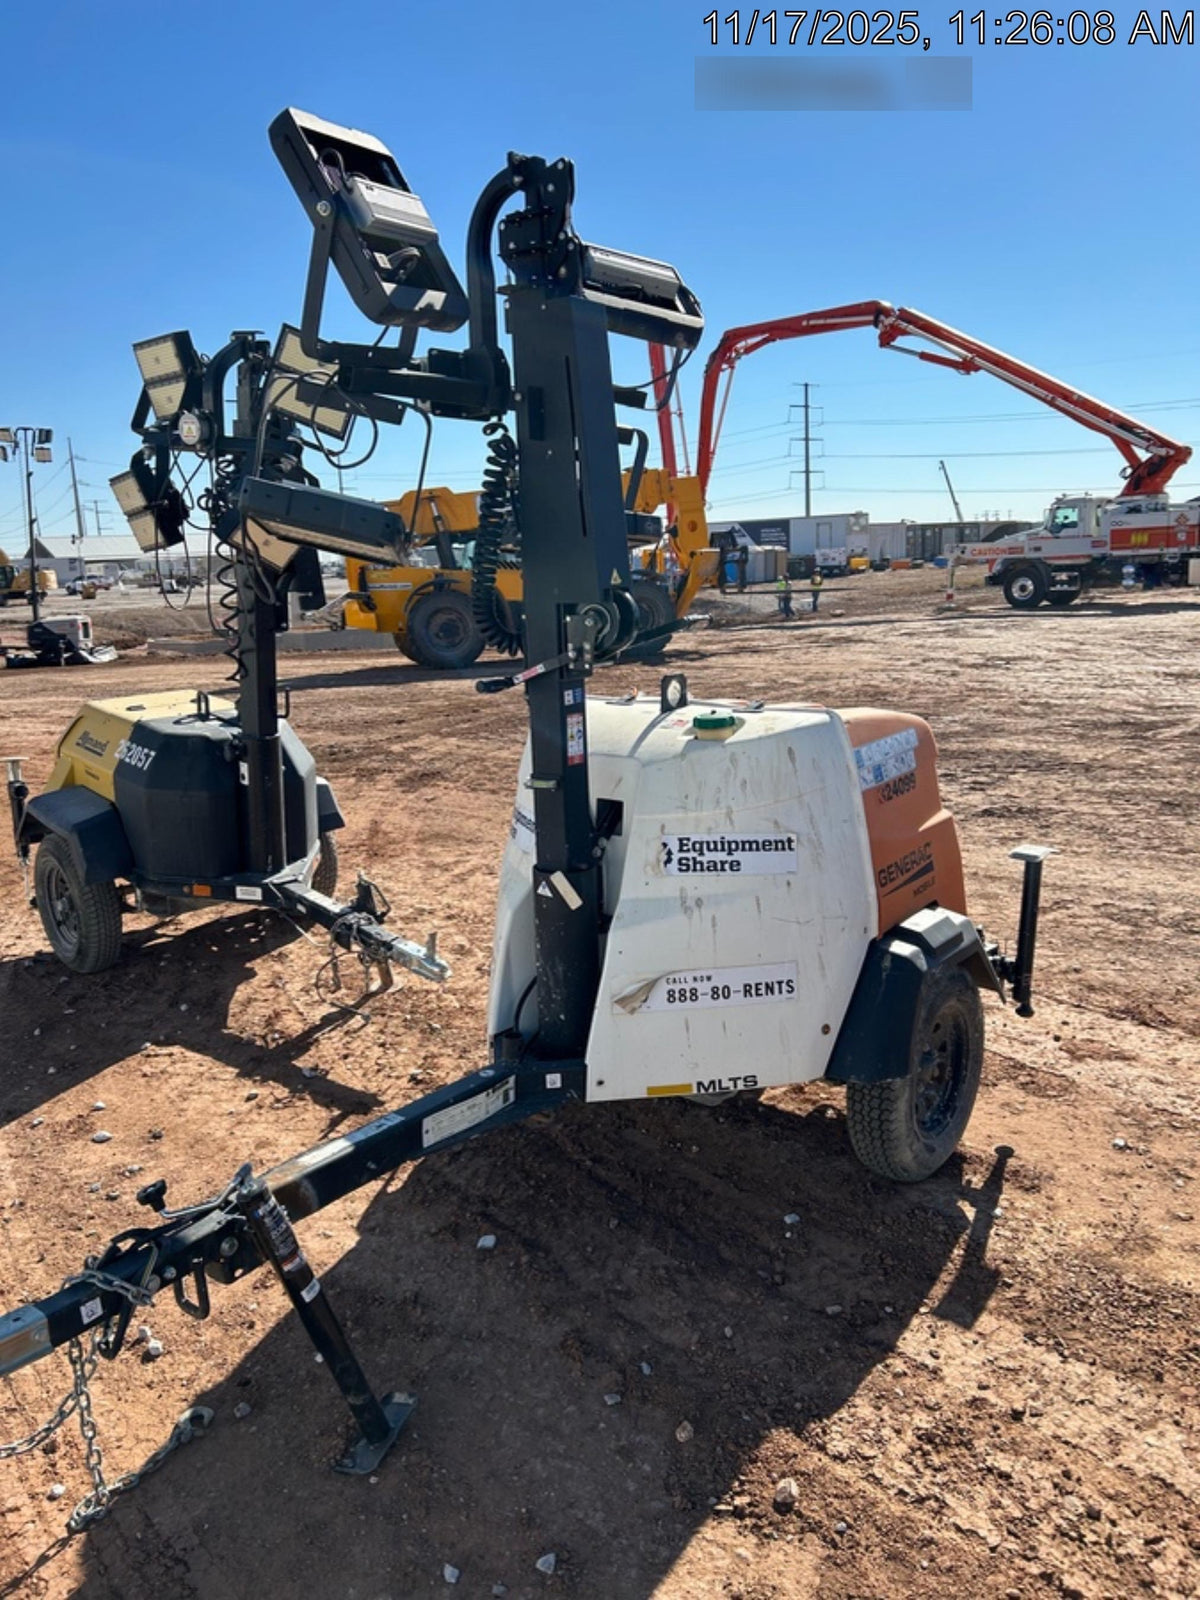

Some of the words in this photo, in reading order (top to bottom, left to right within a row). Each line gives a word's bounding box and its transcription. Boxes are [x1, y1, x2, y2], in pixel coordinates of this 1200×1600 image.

[677, 836, 795, 856] Equipment
[677, 856, 741, 873] Share
[878, 842, 932, 888] GENERAC
[666, 977, 689, 985] CALL
[693, 975, 713, 983] NOW
[666, 979, 796, 1004] 888-80-RENTS
[696, 1075, 758, 1094] MLTS
